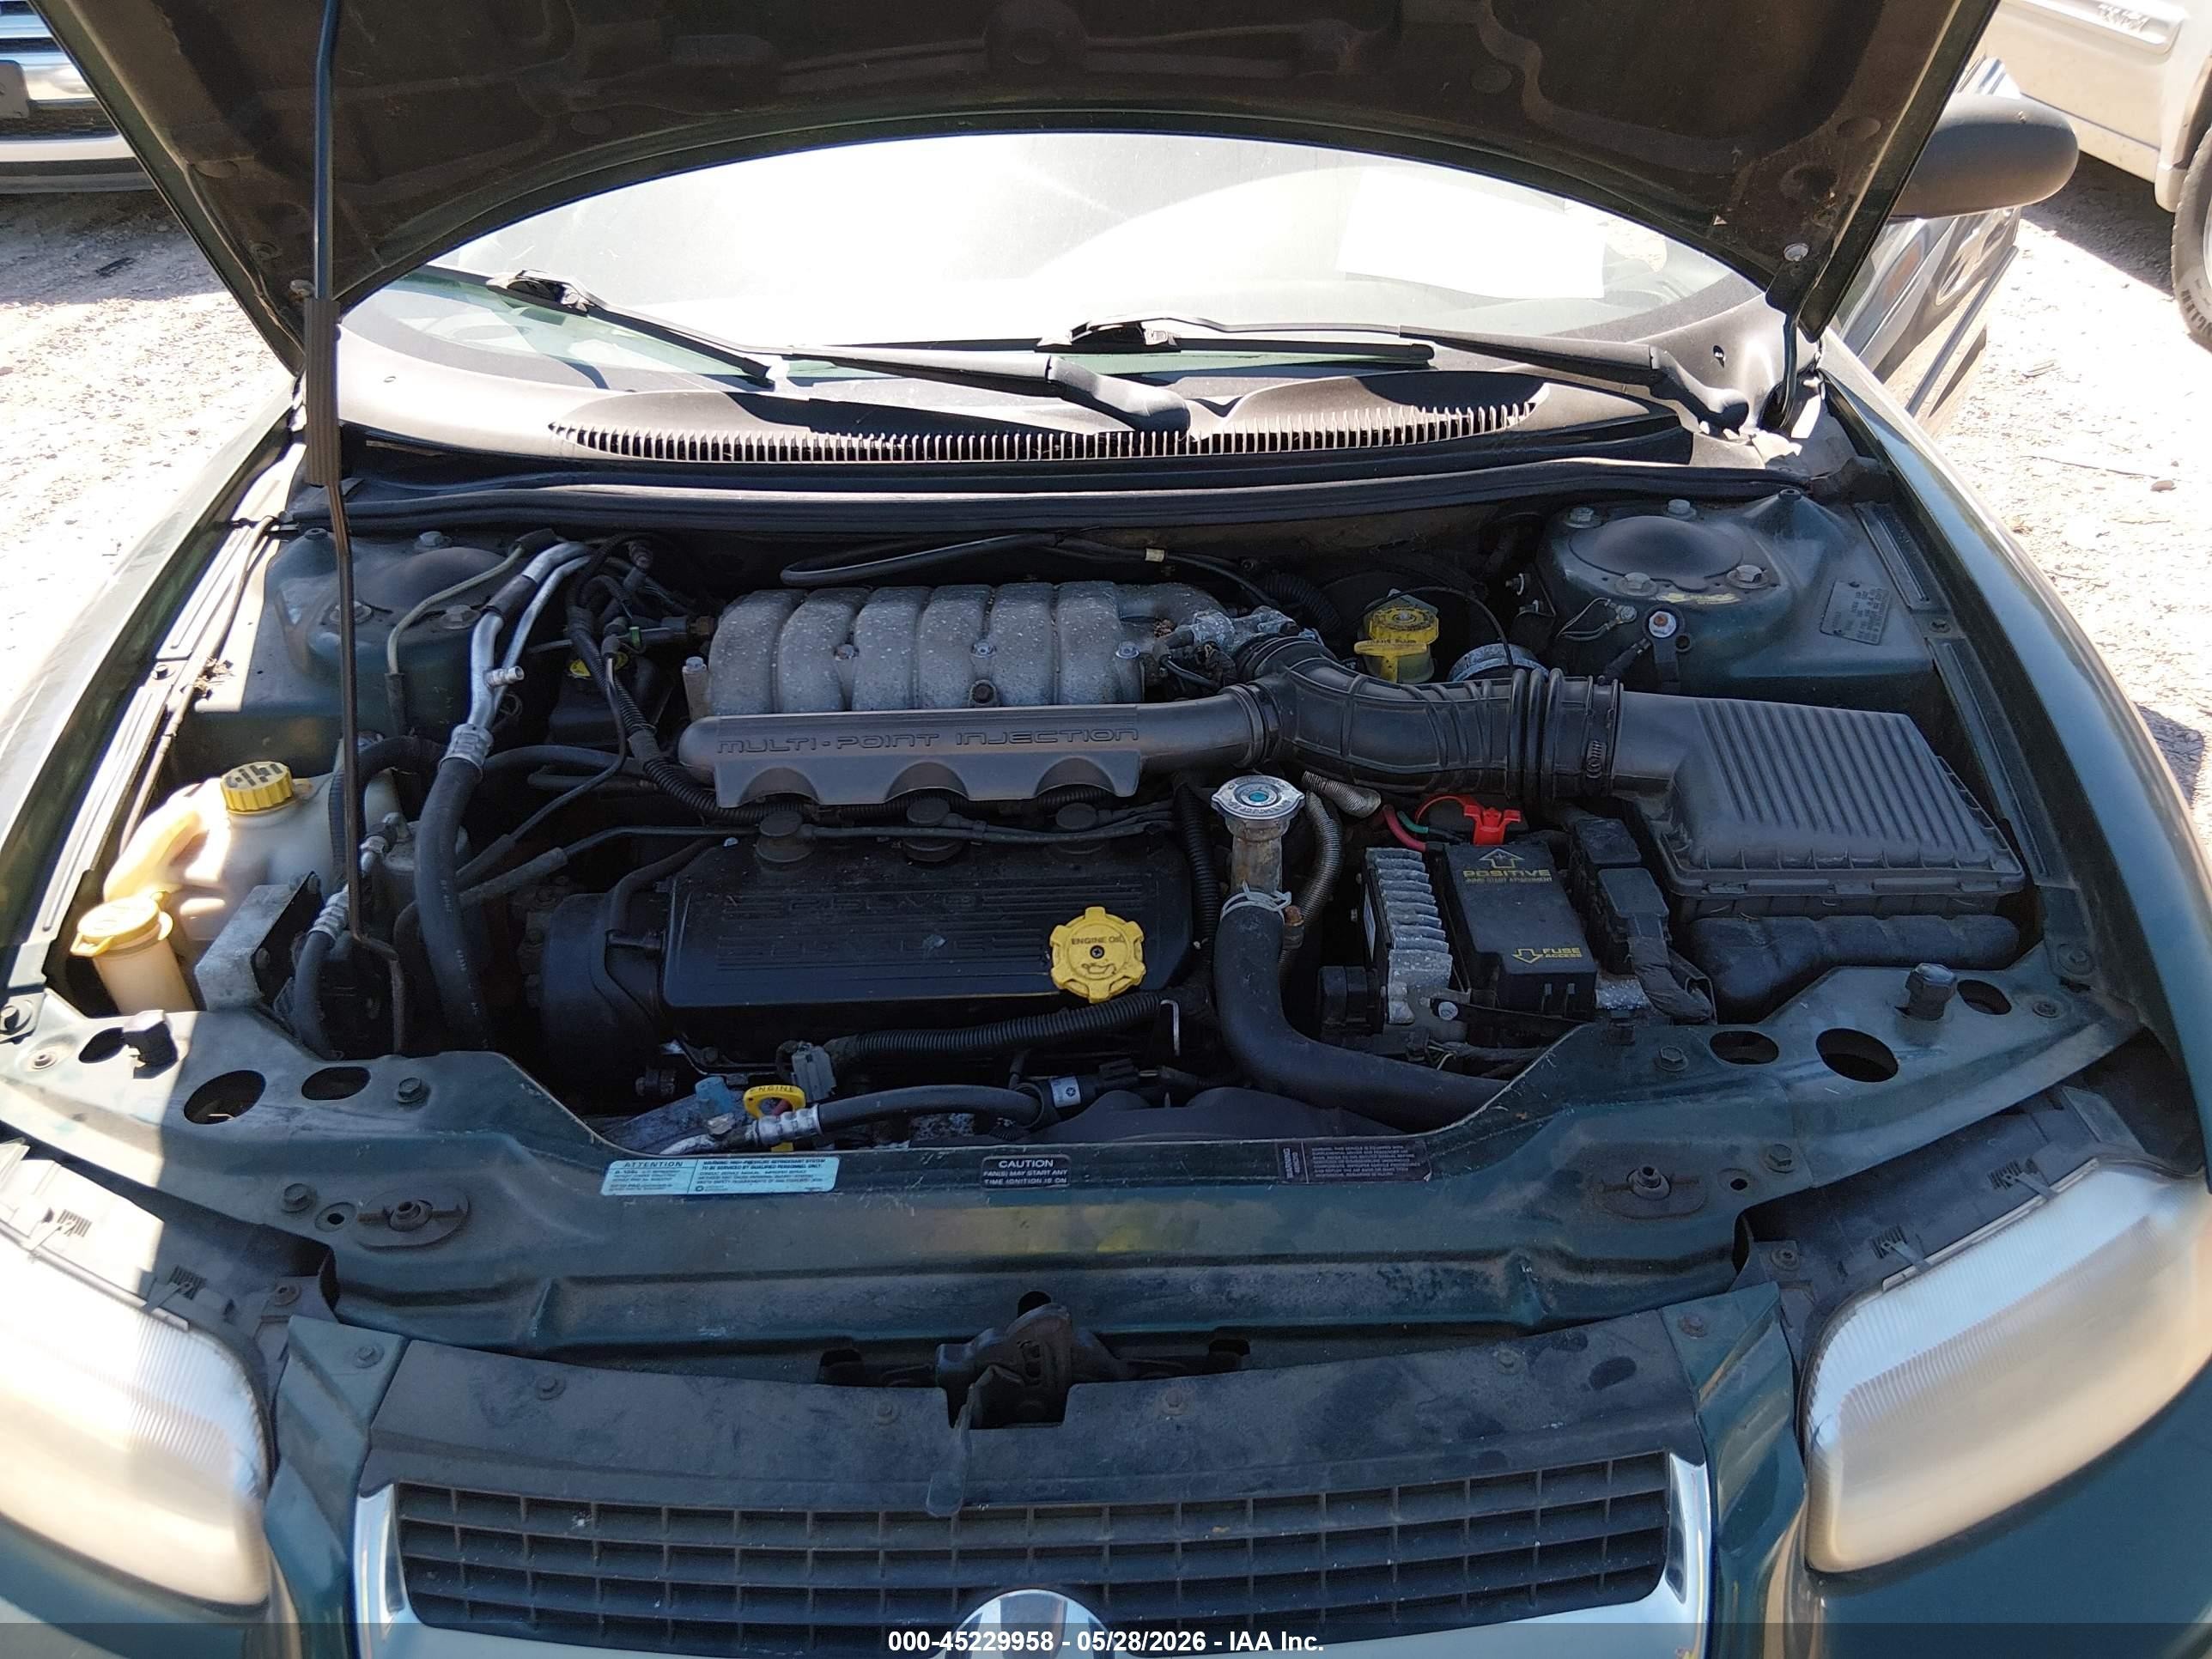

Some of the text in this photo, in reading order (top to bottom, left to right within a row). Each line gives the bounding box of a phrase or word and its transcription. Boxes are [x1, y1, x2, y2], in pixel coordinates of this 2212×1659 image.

[955, 727, 1139, 746] INJECTION
[1463, 869, 1552, 878] POSITIVE
[1071, 936, 1107, 945] ENGINE
[998, 1159, 1054, 1169] CAUTION
